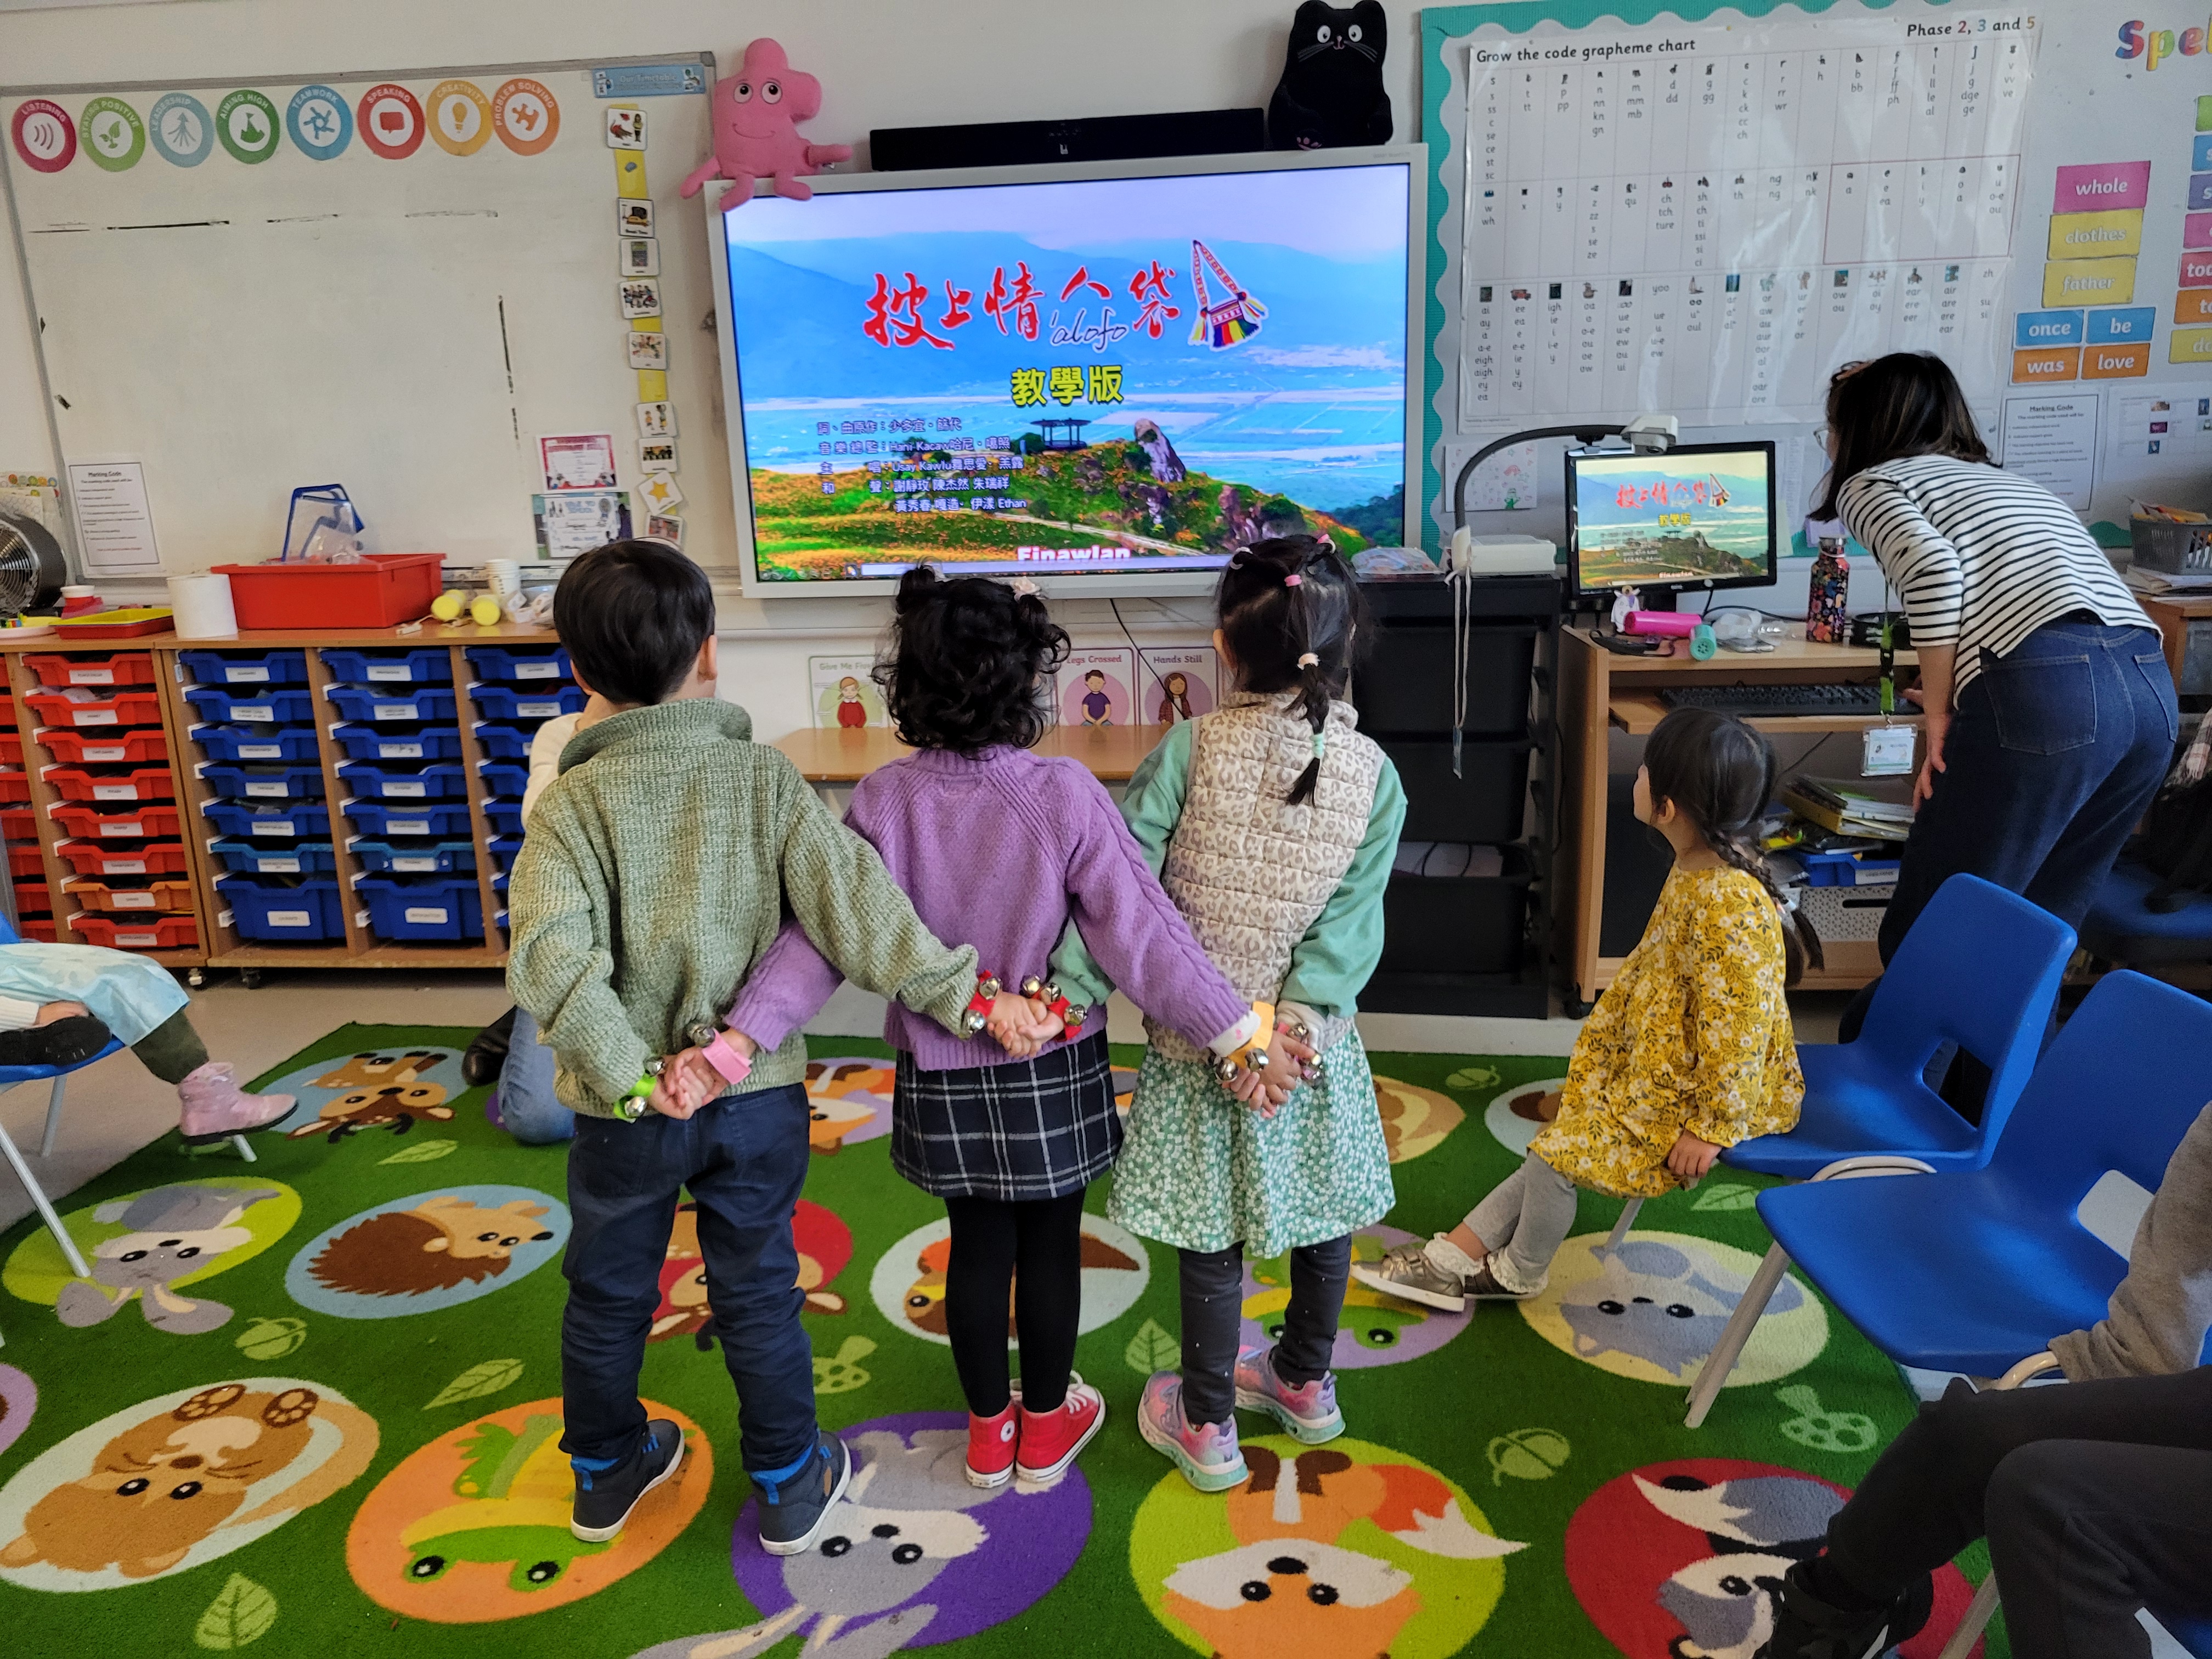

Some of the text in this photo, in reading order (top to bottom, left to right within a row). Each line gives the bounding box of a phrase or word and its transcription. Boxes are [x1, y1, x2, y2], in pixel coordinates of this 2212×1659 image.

[1907, 16, 2036, 37] Phase 2, 3 and 5
[1476, 39, 1695, 63] Grow the code grapheme chart
[1817, 71, 1824, 81] h
[1855, 69, 1861, 79] b
[1669, 80, 1676, 89] d
[1851, 82, 1863, 93] bb
[292, 88, 338, 109] TEAMWORK
[366, 88, 411, 104] SPEAKING
[437, 84, 486, 105] CREATIVITY
[1666, 93, 1678, 103] dd
[1702, 93, 1714, 105] gg
[1927, 92, 1936, 102] le
[1961, 91, 1979, 103] dge
[219, 94, 269, 120] AIMING HIGH
[494, 82, 555, 126] PROBLEM SOLVING
[1557, 102, 1570, 112] pp
[1887, 94, 1900, 108] ph
[21, 103, 66, 122] LISTENING
[100, 100, 139, 128] POSITIVE
[151, 97, 191, 131] LEADERSHIP
[1593, 111, 1604, 120] kn
[1627, 109, 1643, 119] mb
[1925, 105, 1935, 116] al
[1962, 106, 1975, 117] ge
[1592, 127, 1604, 137] gn
[1769, 175, 1782, 186] ng
[2076, 178, 2128, 195] whole
[1661, 194, 1672, 204] ch
[1697, 192, 1708, 202] sh
[1769, 190, 1781, 201] ng
[1658, 207, 1673, 217] tch
[1696, 205, 1707, 215] ch
[1481, 216, 1495, 225] wh
[2065, 228, 2126, 243] clothes
[2061, 276, 2115, 296] father
[862, 260, 1181, 351] 披上情人袋
[2028, 322, 2070, 336] once
[2110, 318, 2131, 334] be
[2027, 360, 2064, 374] was
[2097, 354, 2134, 370] love
[1011, 365, 1124, 406] 教學版
[998, 498, 1027, 509] Ethan
[1017, 545, 1131, 563] Finawlan
[1066, 654, 1122, 665] Legs Crossed
[1154, 654, 1203, 664] Hands Still
